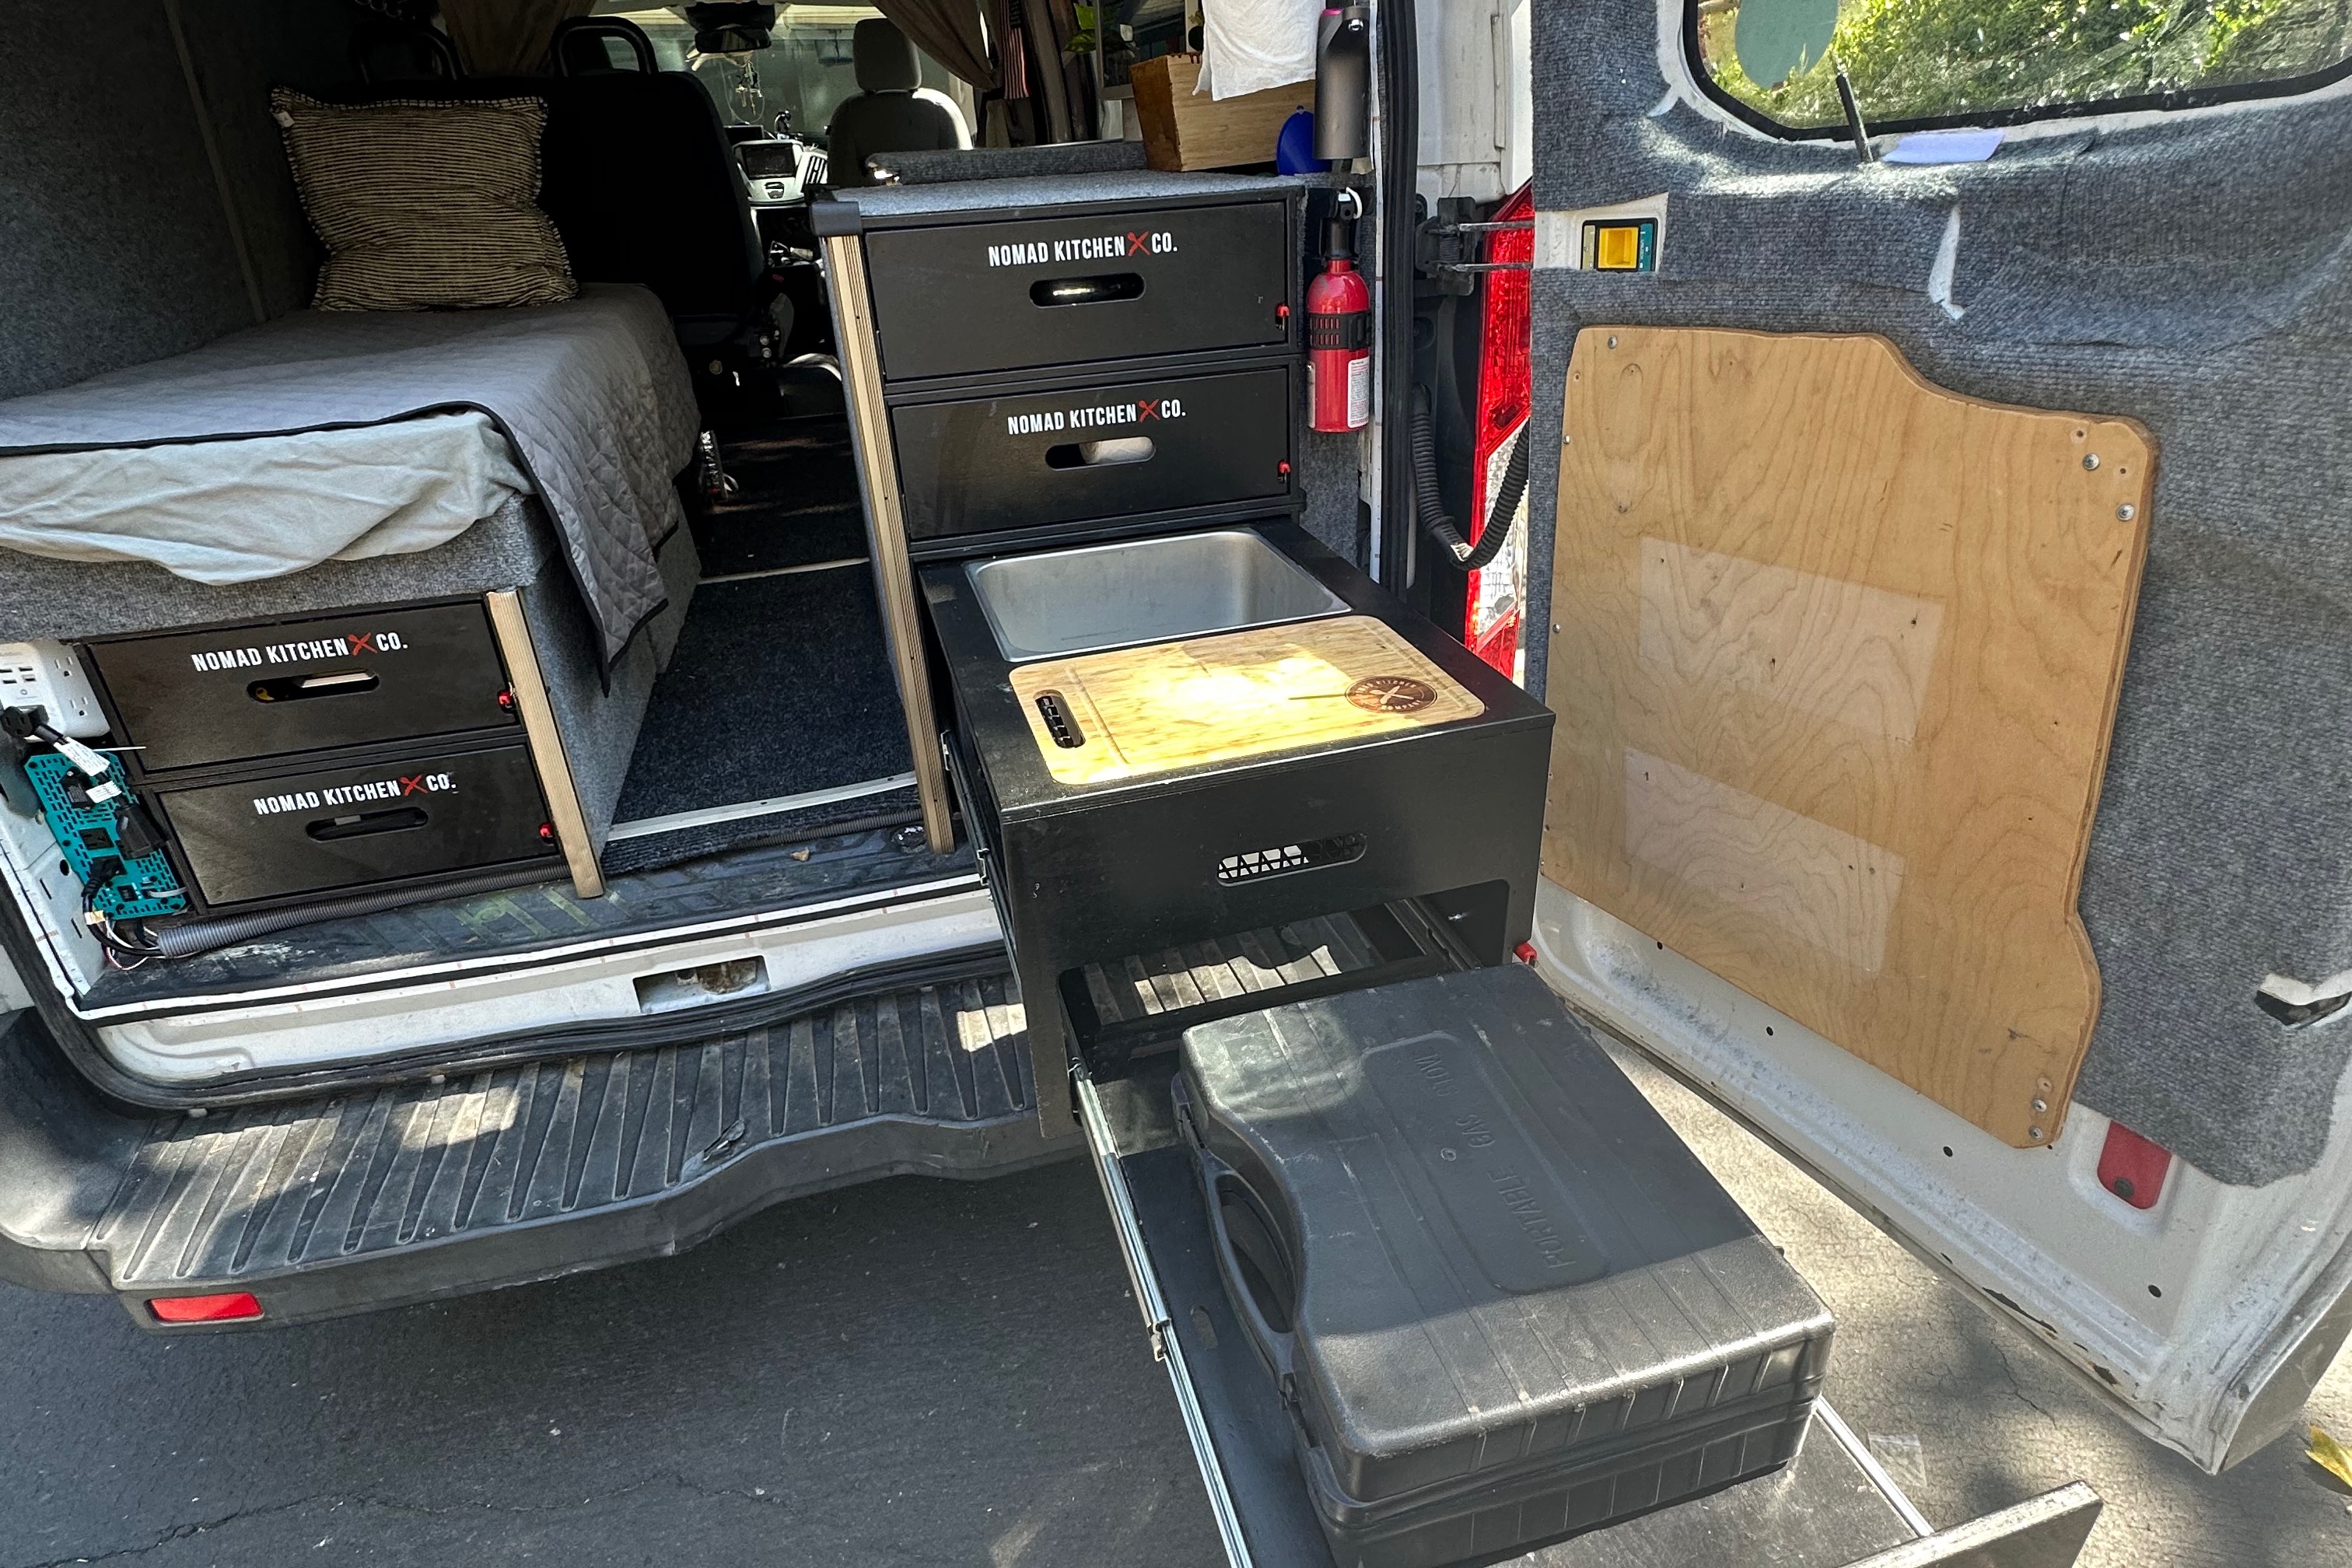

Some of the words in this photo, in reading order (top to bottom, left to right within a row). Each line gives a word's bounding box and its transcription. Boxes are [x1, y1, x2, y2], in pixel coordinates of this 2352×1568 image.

[988, 242, 1048, 267] NOMAD
[1054, 236, 1125, 261] KITCHEN
[1151, 232, 1178, 254] CO.
[1007, 411, 1064, 435] NOMAD
[1069, 404, 1136, 428] KITCHEN
[1161, 399, 1186, 418] CO.
[191, 647, 262, 672] NOMAD
[265, 638, 350, 664] KITCHEN
[376, 632, 408, 653] CO.
[253, 791, 320, 815] NOMAD
[323, 780, 401, 806] KITCHEN
[425, 774, 457, 792] CO.
[1455, 1114, 1496, 1148] GAS
[1486, 1166, 1578, 1269] PORTABLE
